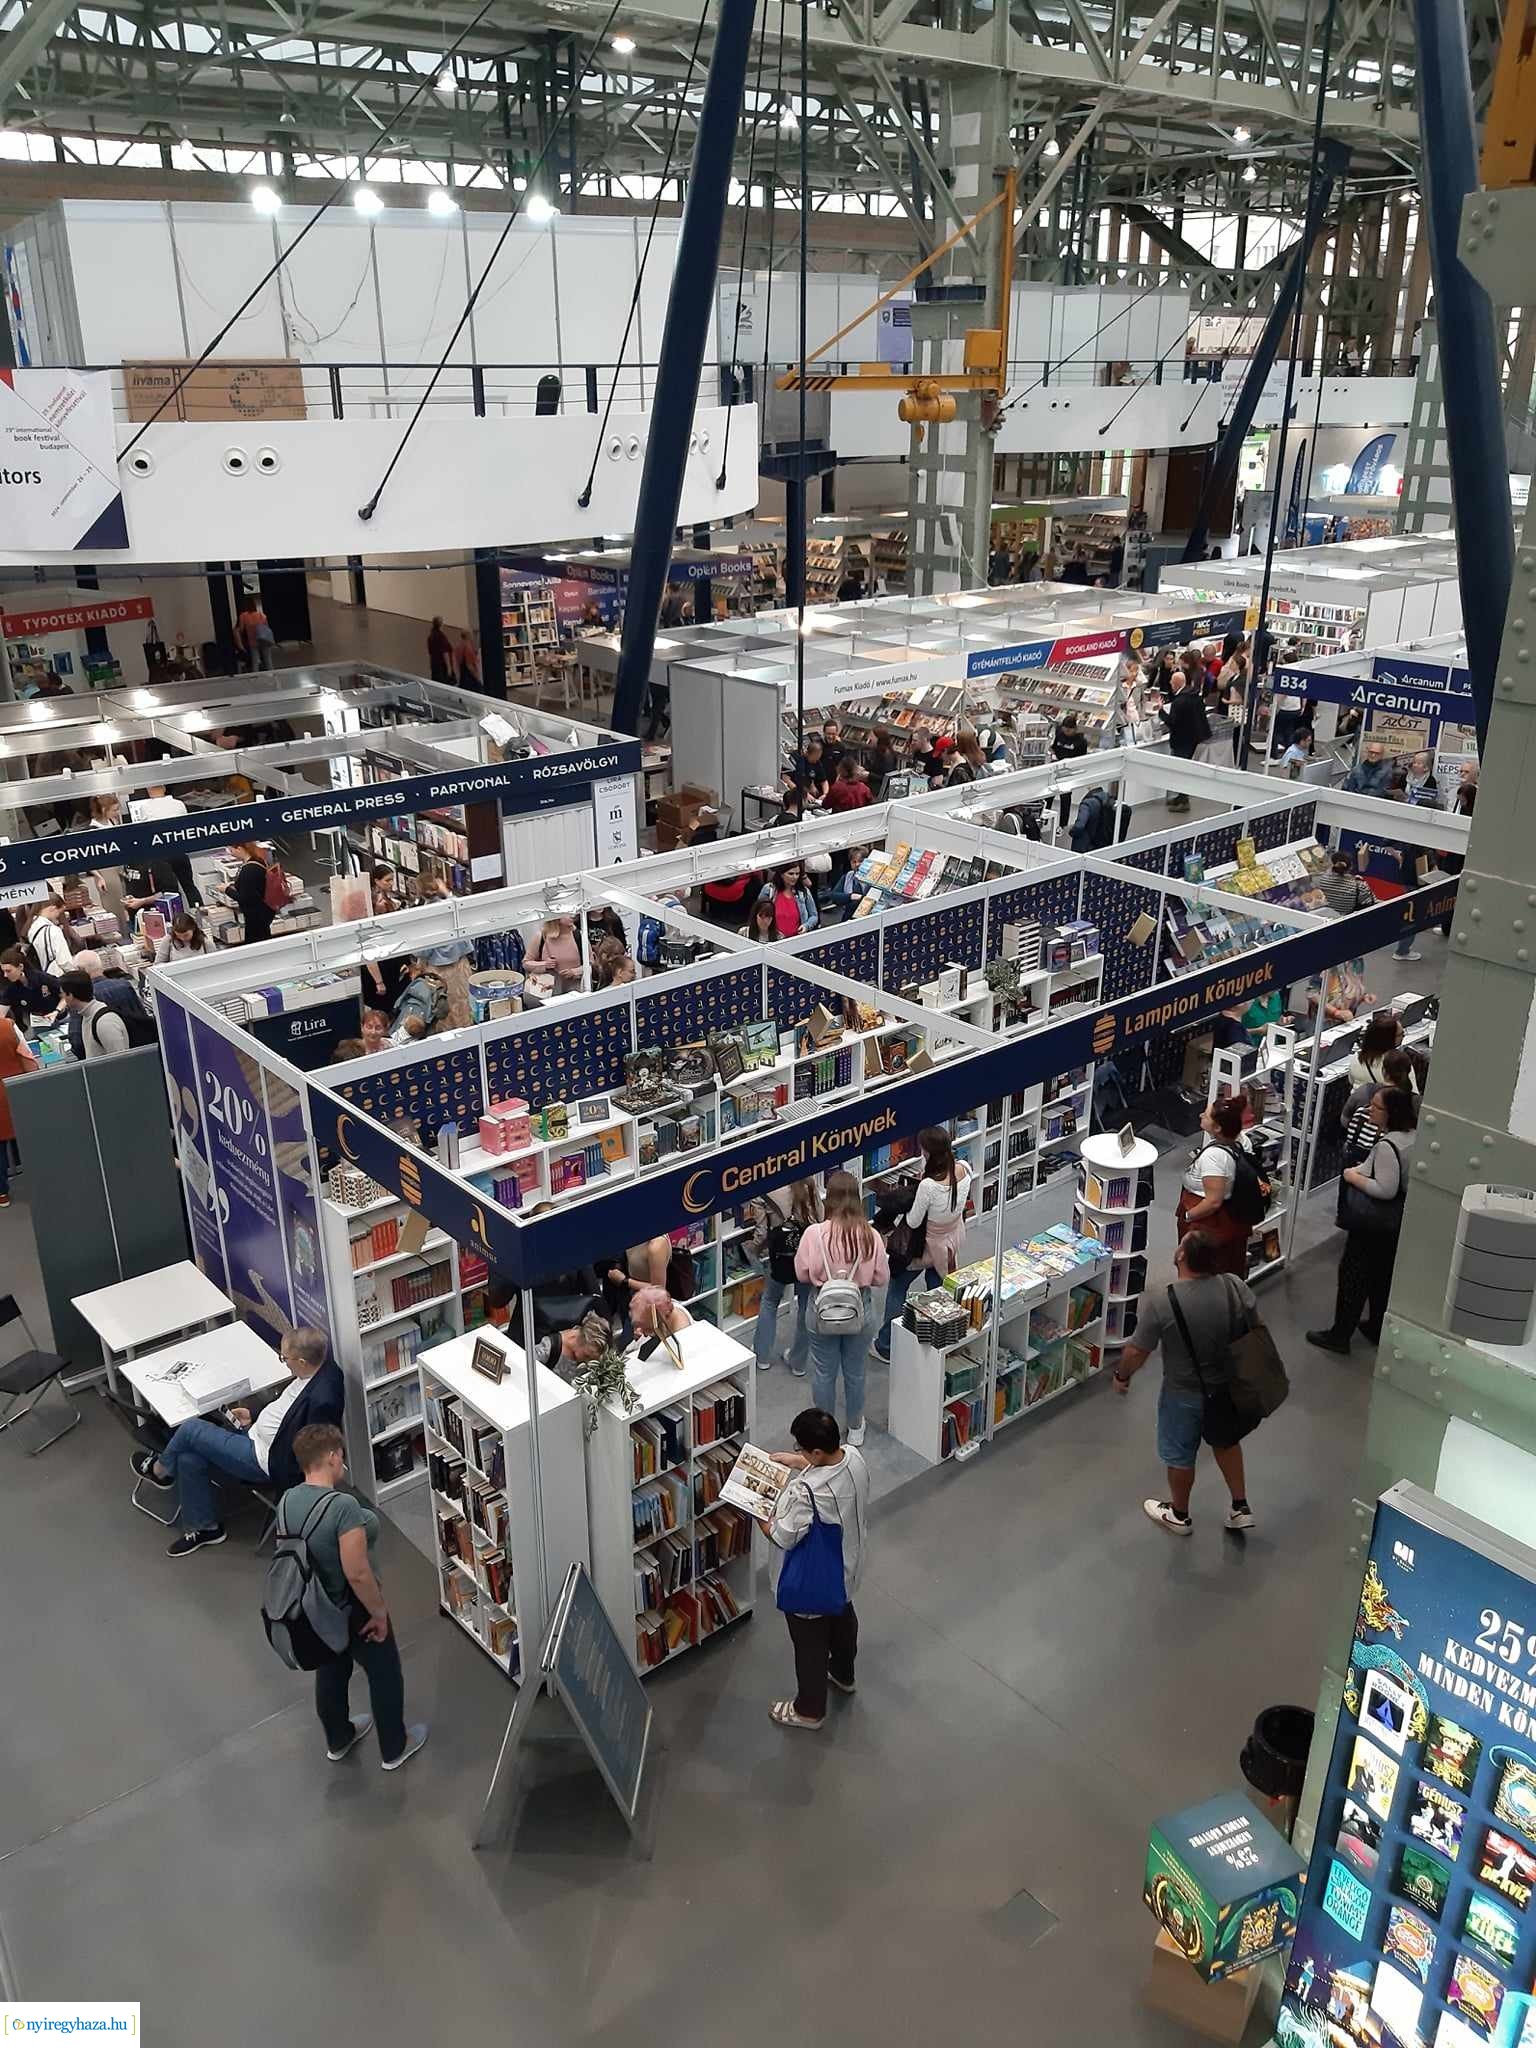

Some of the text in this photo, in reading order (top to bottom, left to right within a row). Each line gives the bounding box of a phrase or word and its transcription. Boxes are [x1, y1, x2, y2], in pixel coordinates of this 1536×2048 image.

[14, 433, 60, 442] book festival
[720, 562, 752, 575] Books
[23, 603, 128, 631] TYPOTEX KIADÓ
[1023, 651, 1043, 664] KIADÓ
[1065, 637, 1118, 656] BOOKLAND KIADÓ
[833, 683, 853, 695] Fumax
[854, 680, 871, 692] Kiadó
[875, 672, 918, 688] www.fumax.hu
[1279, 675, 1308, 691] B34
[1401, 673, 1444, 690] Arcanum
[1351, 684, 1442, 716] Arcanum
[40, 841, 121, 866] CORVINA
[151, 817, 254, 846] ATHENAEUM
[281, 802, 352, 823] GENERAL
[355, 792, 406, 811] PRESS
[430, 775, 511, 798] PARTVONAL
[533, 754, 619, 780] RÓZSAVÖLGYI
[1124, 961, 1274, 1036] Lampion Könyvek
[206, 1070, 266, 1157] 20%
[721, 1107, 897, 1193] Central Könyvek
[1417, 1652, 1495, 1714] MINDEN
[1422, 1785, 1464, 1815] GÉNIUSZ
[1225, 1847, 1260, 1872] 25%
